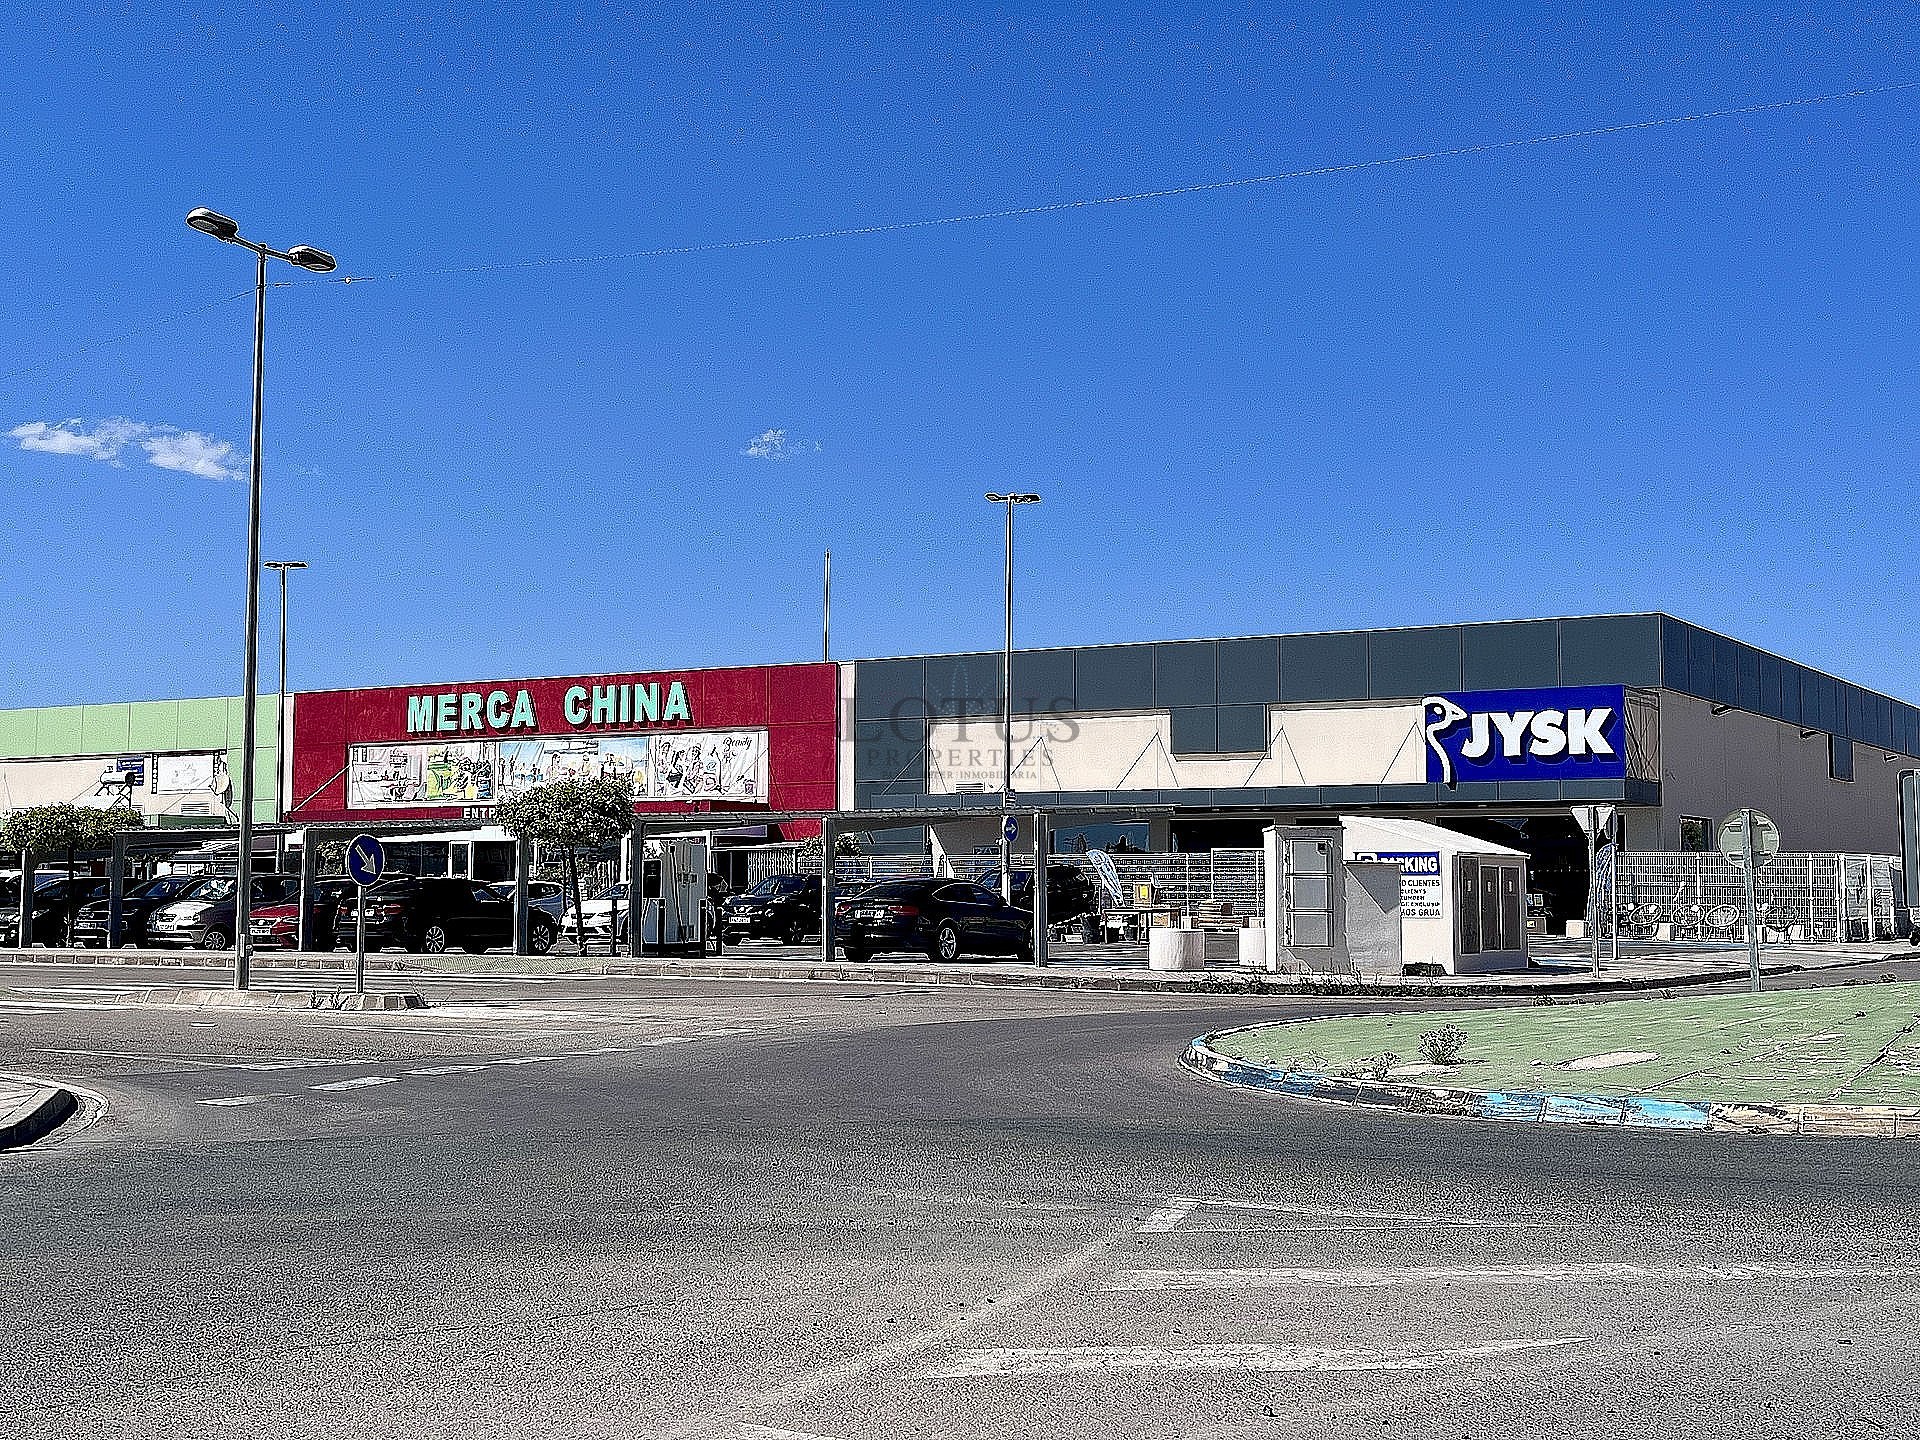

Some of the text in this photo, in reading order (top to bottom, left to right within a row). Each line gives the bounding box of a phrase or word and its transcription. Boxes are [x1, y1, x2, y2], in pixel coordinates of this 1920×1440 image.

[406, 680, 692, 733] MERCA CHINA
[1461, 706, 1615, 759] JYSK
